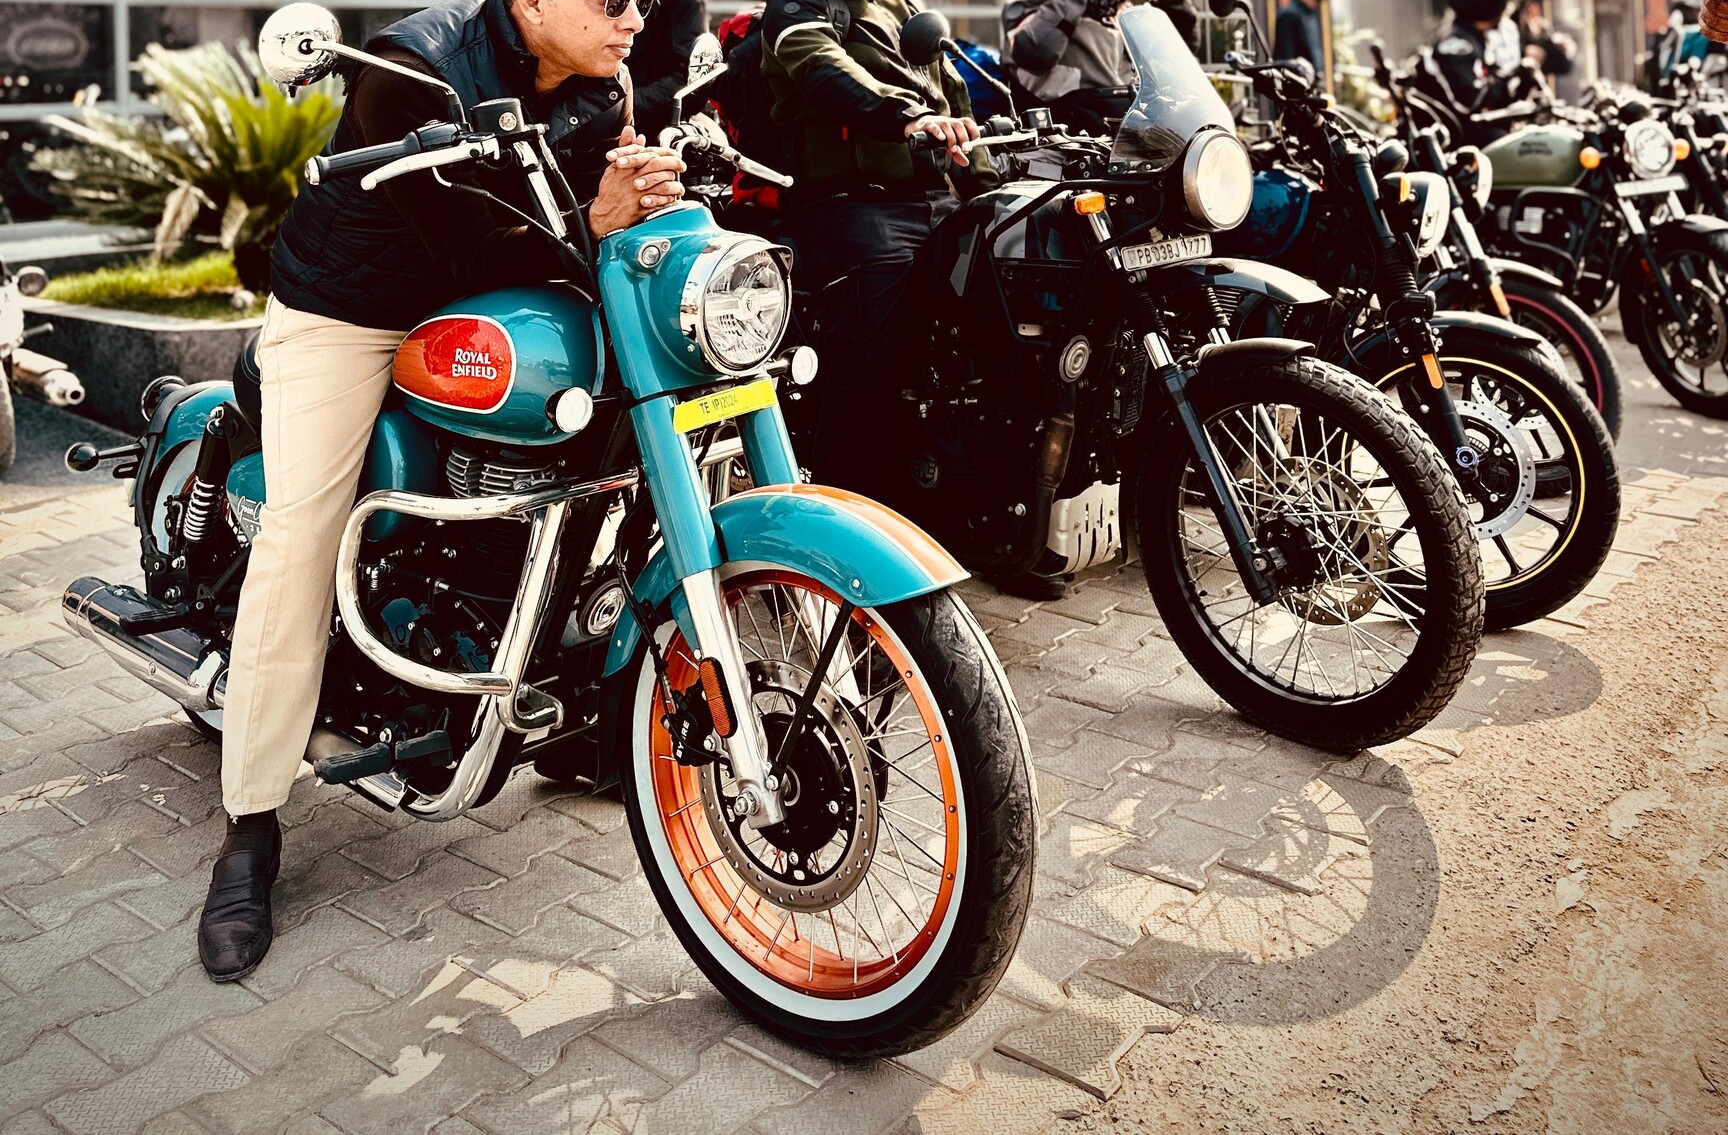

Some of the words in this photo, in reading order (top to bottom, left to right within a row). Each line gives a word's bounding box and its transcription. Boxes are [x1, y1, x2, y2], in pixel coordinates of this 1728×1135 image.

[454, 347, 492, 365] ROYAL
[451, 363, 498, 381] ENFIELD
[699, 401, 710, 415] TE
[675, 719, 690, 759] BYRE
